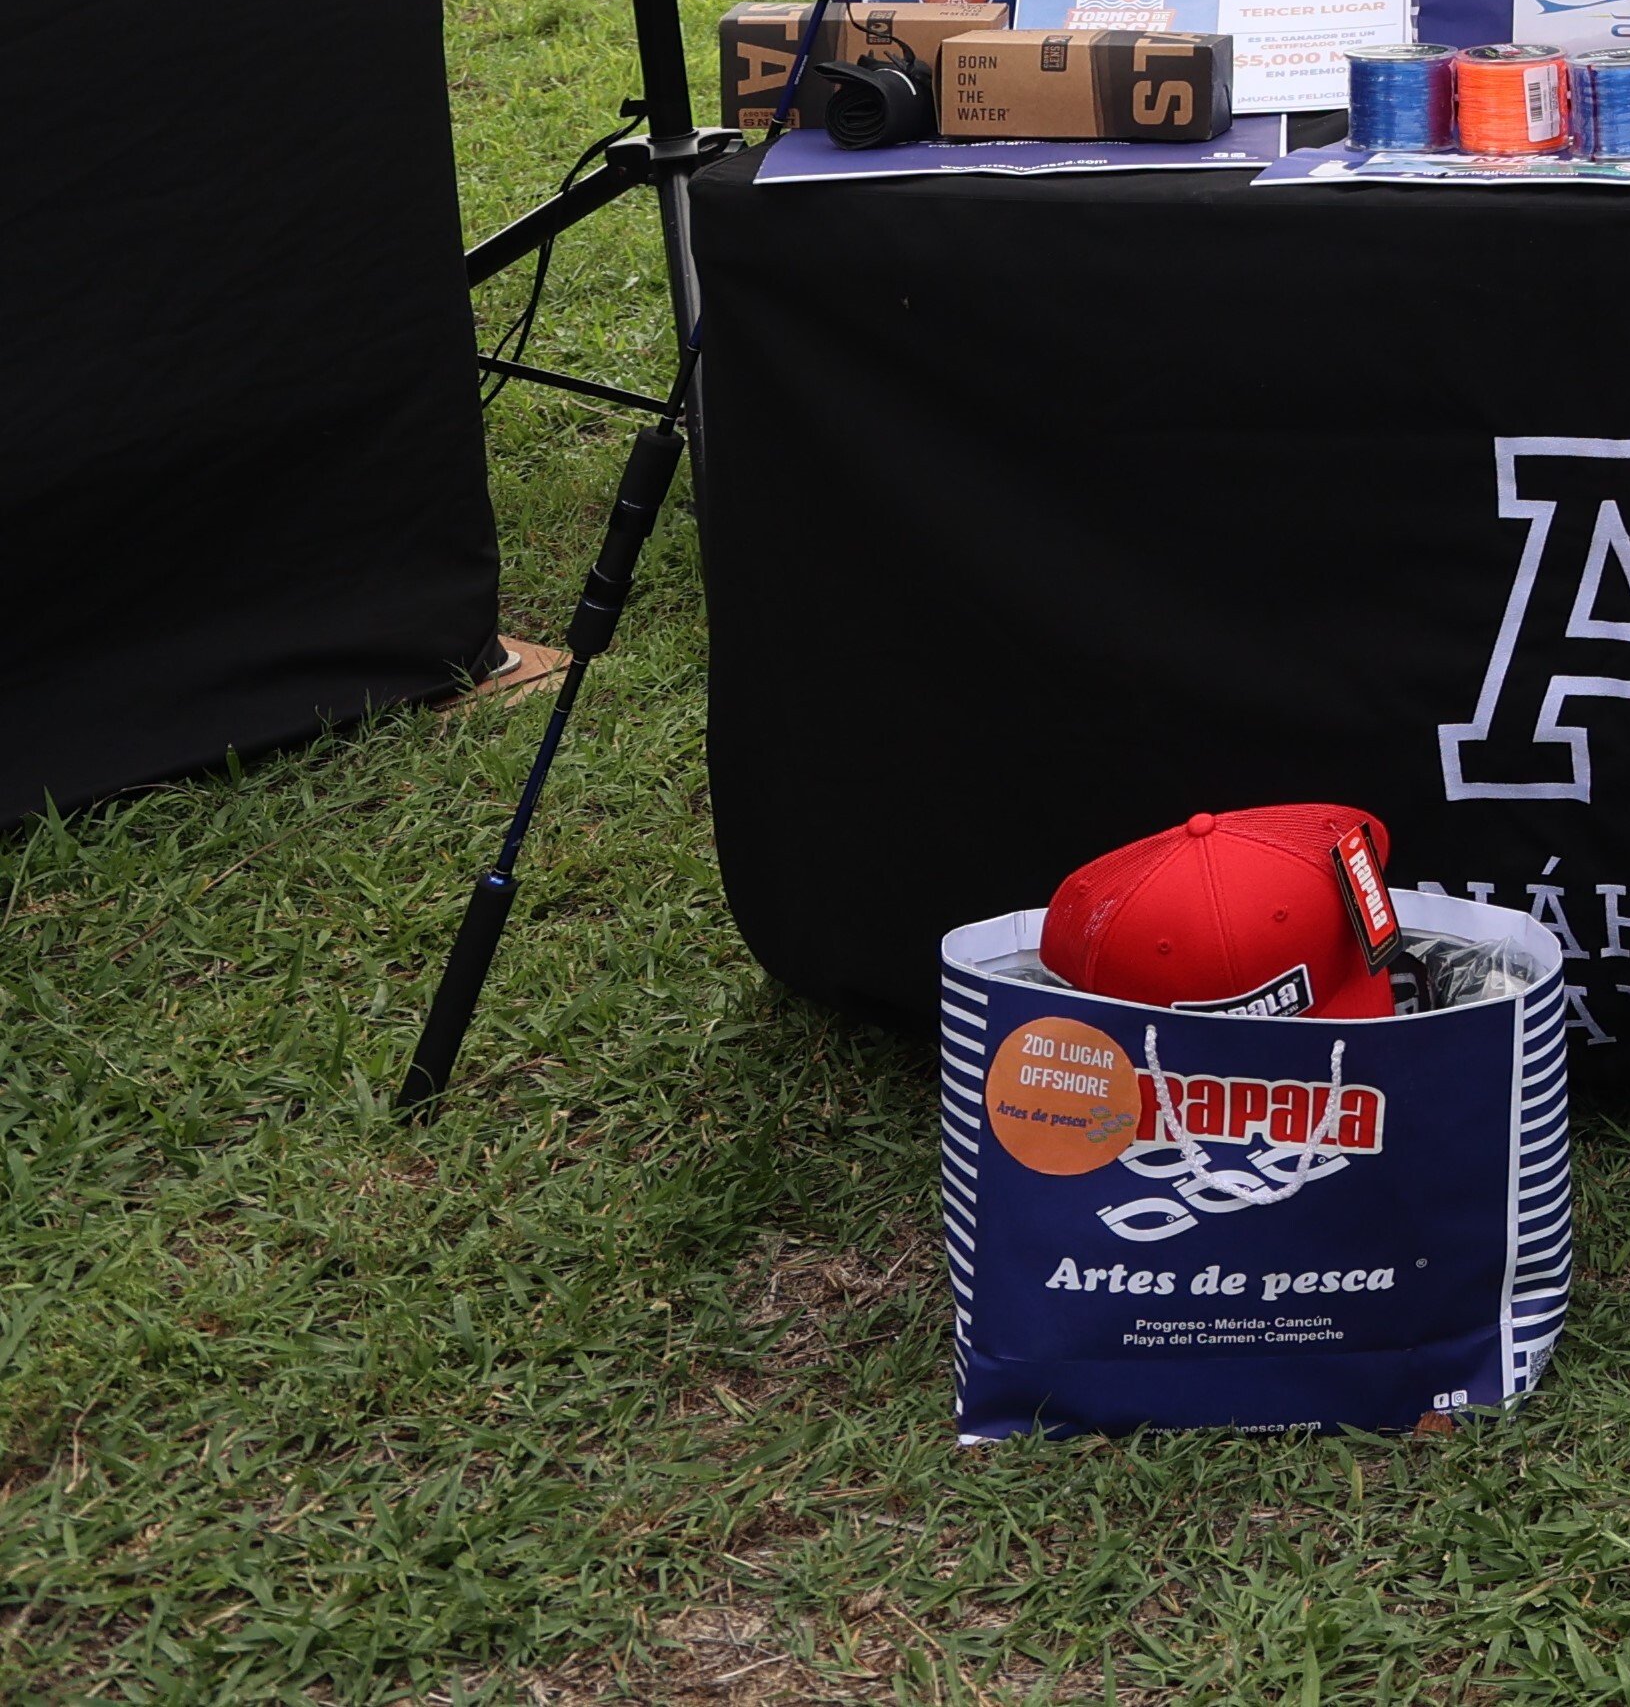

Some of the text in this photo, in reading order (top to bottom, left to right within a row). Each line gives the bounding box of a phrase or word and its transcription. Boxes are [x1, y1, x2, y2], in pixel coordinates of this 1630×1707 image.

[1072, 10, 1150, 23] TORNEO
[1239, 6, 1315, 18] TERCER
[1282, 33, 1338, 42] GANADOR
[1260, 42, 1336, 50] CERTIFICADO
[957, 54, 998, 70] BORN
[1235, 52, 1321, 69] $5,000
[957, 72, 978, 87] ON
[957, 90, 984, 104] THE
[1021, 1033, 1115, 1071] 2DO LUGAR
[1019, 1065, 1110, 1098] OFFSHORE
[1045, 1258, 1396, 1301] Artes de pesca
[1274, 1314, 1333, 1329] Cancún
[1122, 1331, 1192, 1347] Playa del
